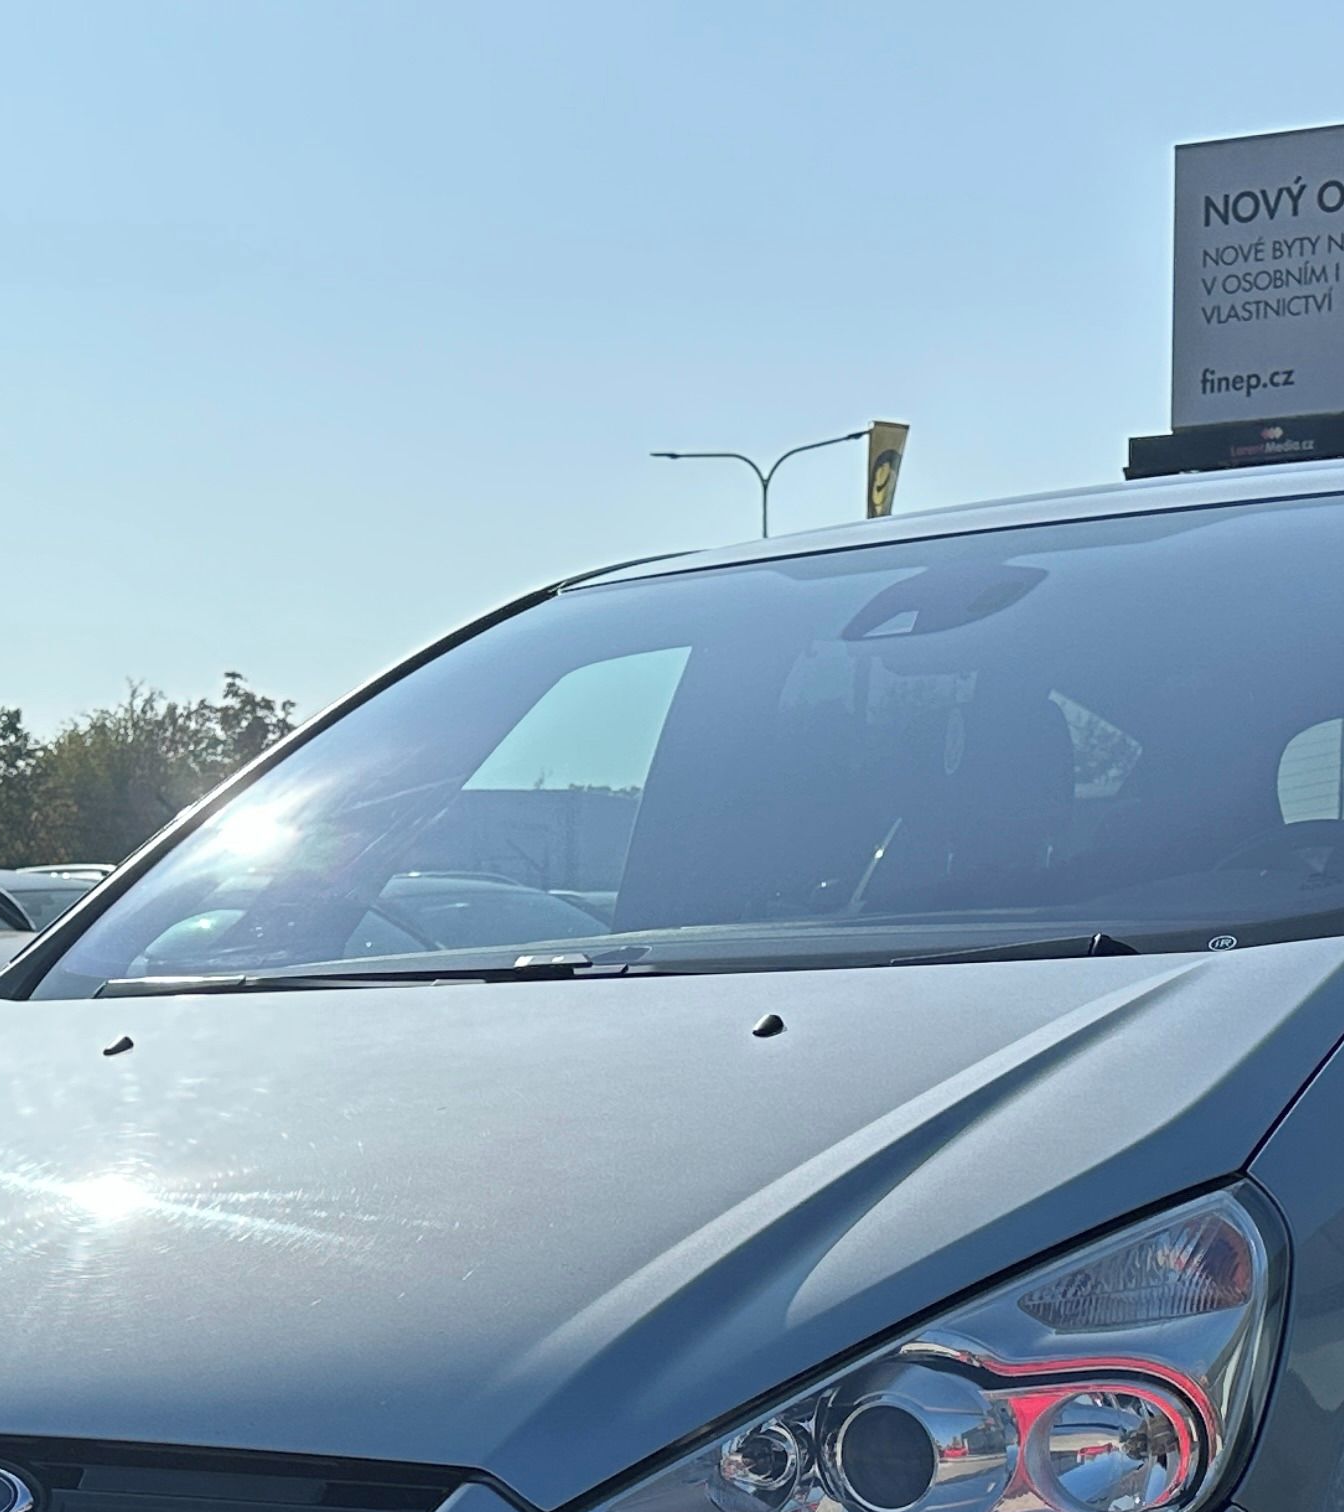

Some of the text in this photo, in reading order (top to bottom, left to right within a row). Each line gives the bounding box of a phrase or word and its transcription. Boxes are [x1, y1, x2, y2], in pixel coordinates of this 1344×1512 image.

[1203, 175, 1307, 227] NOVÝ
[1202, 239, 1265, 268] NOVÉ
[1272, 236, 1321, 261] BYTY
[1201, 276, 1218, 296] V
[1222, 260, 1329, 295] OSOBNÍM
[1334, 264, 1340, 284] I
[1201, 288, 1334, 325] VLASTNICTVÍ
[1200, 368, 1296, 398] finep.cz
